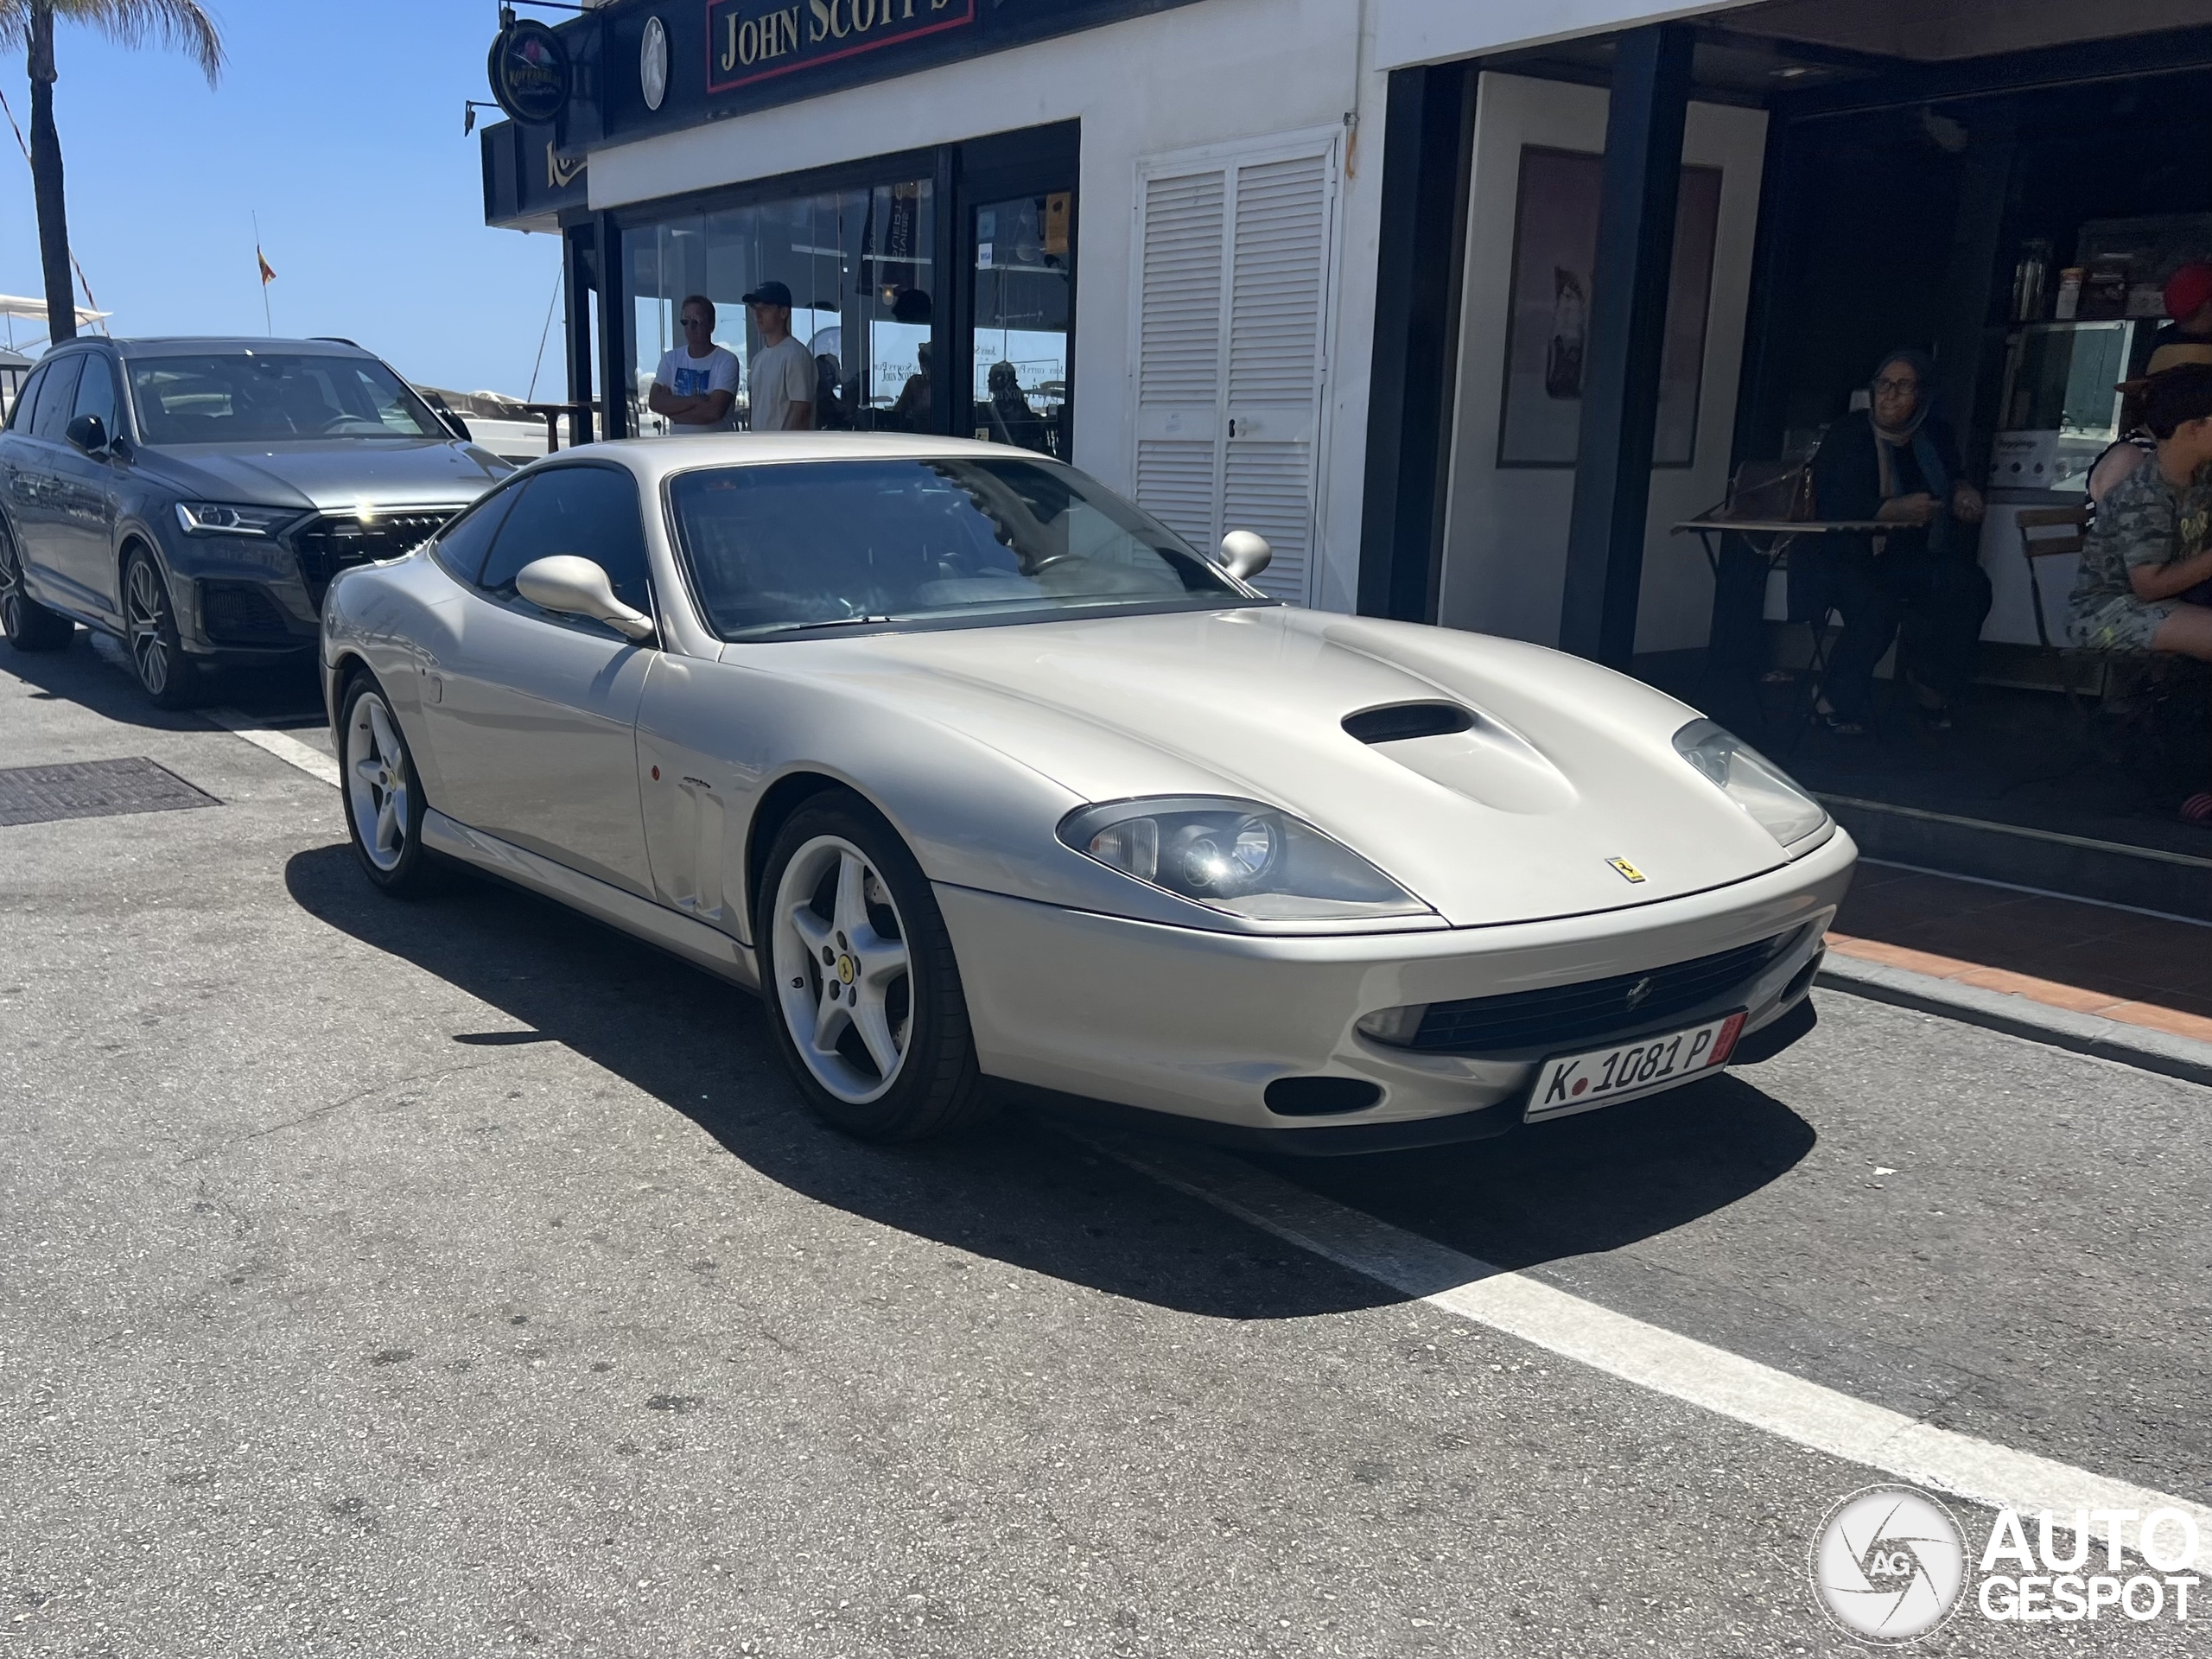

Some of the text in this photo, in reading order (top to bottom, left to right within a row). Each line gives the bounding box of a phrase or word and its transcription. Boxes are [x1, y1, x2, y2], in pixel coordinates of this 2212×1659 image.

[721, 0, 948, 71] JOHN SCOT
[980, 251, 991, 260] VISA
[1545, 1060, 1580, 1104] K
[1592, 1035, 1683, 1093] 1081
[1684, 1029, 1712, 1070] P
